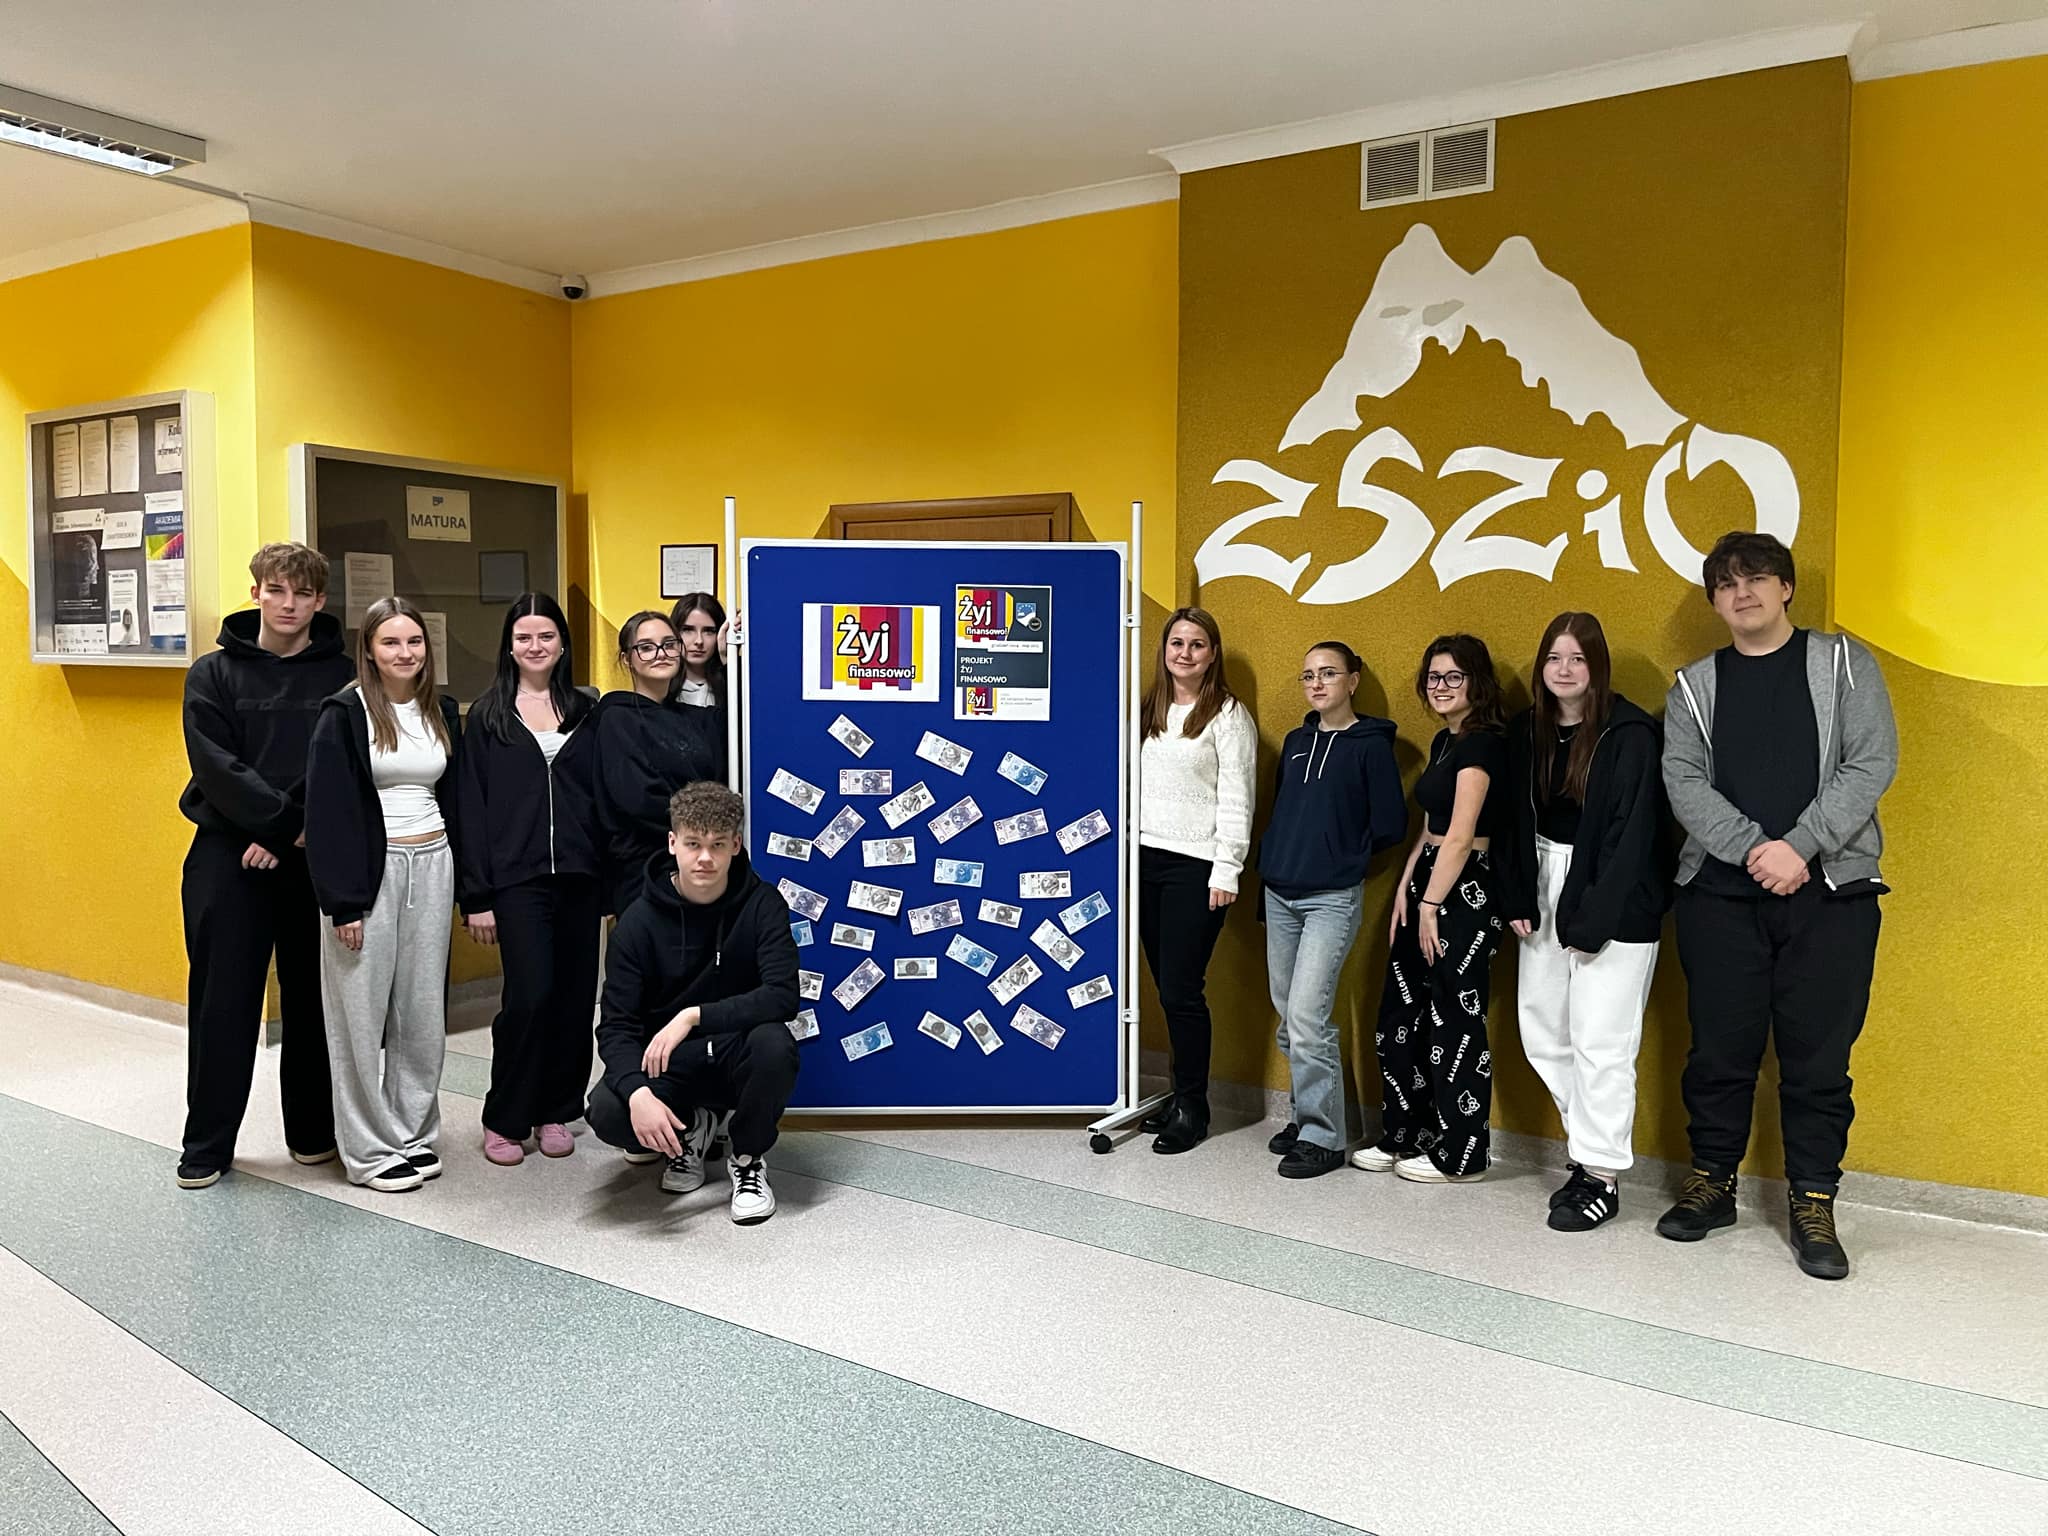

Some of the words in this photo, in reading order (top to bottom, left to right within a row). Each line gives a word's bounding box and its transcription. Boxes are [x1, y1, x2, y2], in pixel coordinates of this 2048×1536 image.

[411, 513, 467, 529] MATURA
[959, 595, 992, 627] Żyj
[966, 626, 1008, 636] finansowo!
[836, 614, 891, 664] Żyj
[960, 656, 993, 665] PROJEKT
[848, 664, 916, 679] finansowo!
[960, 664, 973, 674] ŻYJ
[960, 675, 1007, 684] FINANSOWO
[968, 690, 986, 707] Żyj
[840, 770, 848, 780] 20
[929, 822, 938, 832] 20
[995, 821, 1003, 831] 20
[1056, 830, 1066, 841] 20
[814, 838, 825, 848] 20
[779, 880, 788, 890] 20
[909, 910, 916, 921] 20
[1467, 930, 1486, 955] HELLO
[834, 990, 844, 999] 20
[1398, 980, 1414, 1005] HELLO
[1020, 1005, 1028, 1015] 20
[1455, 1033, 1471, 1059] HELLO
[1462, 1135, 1478, 1160] HELLO
